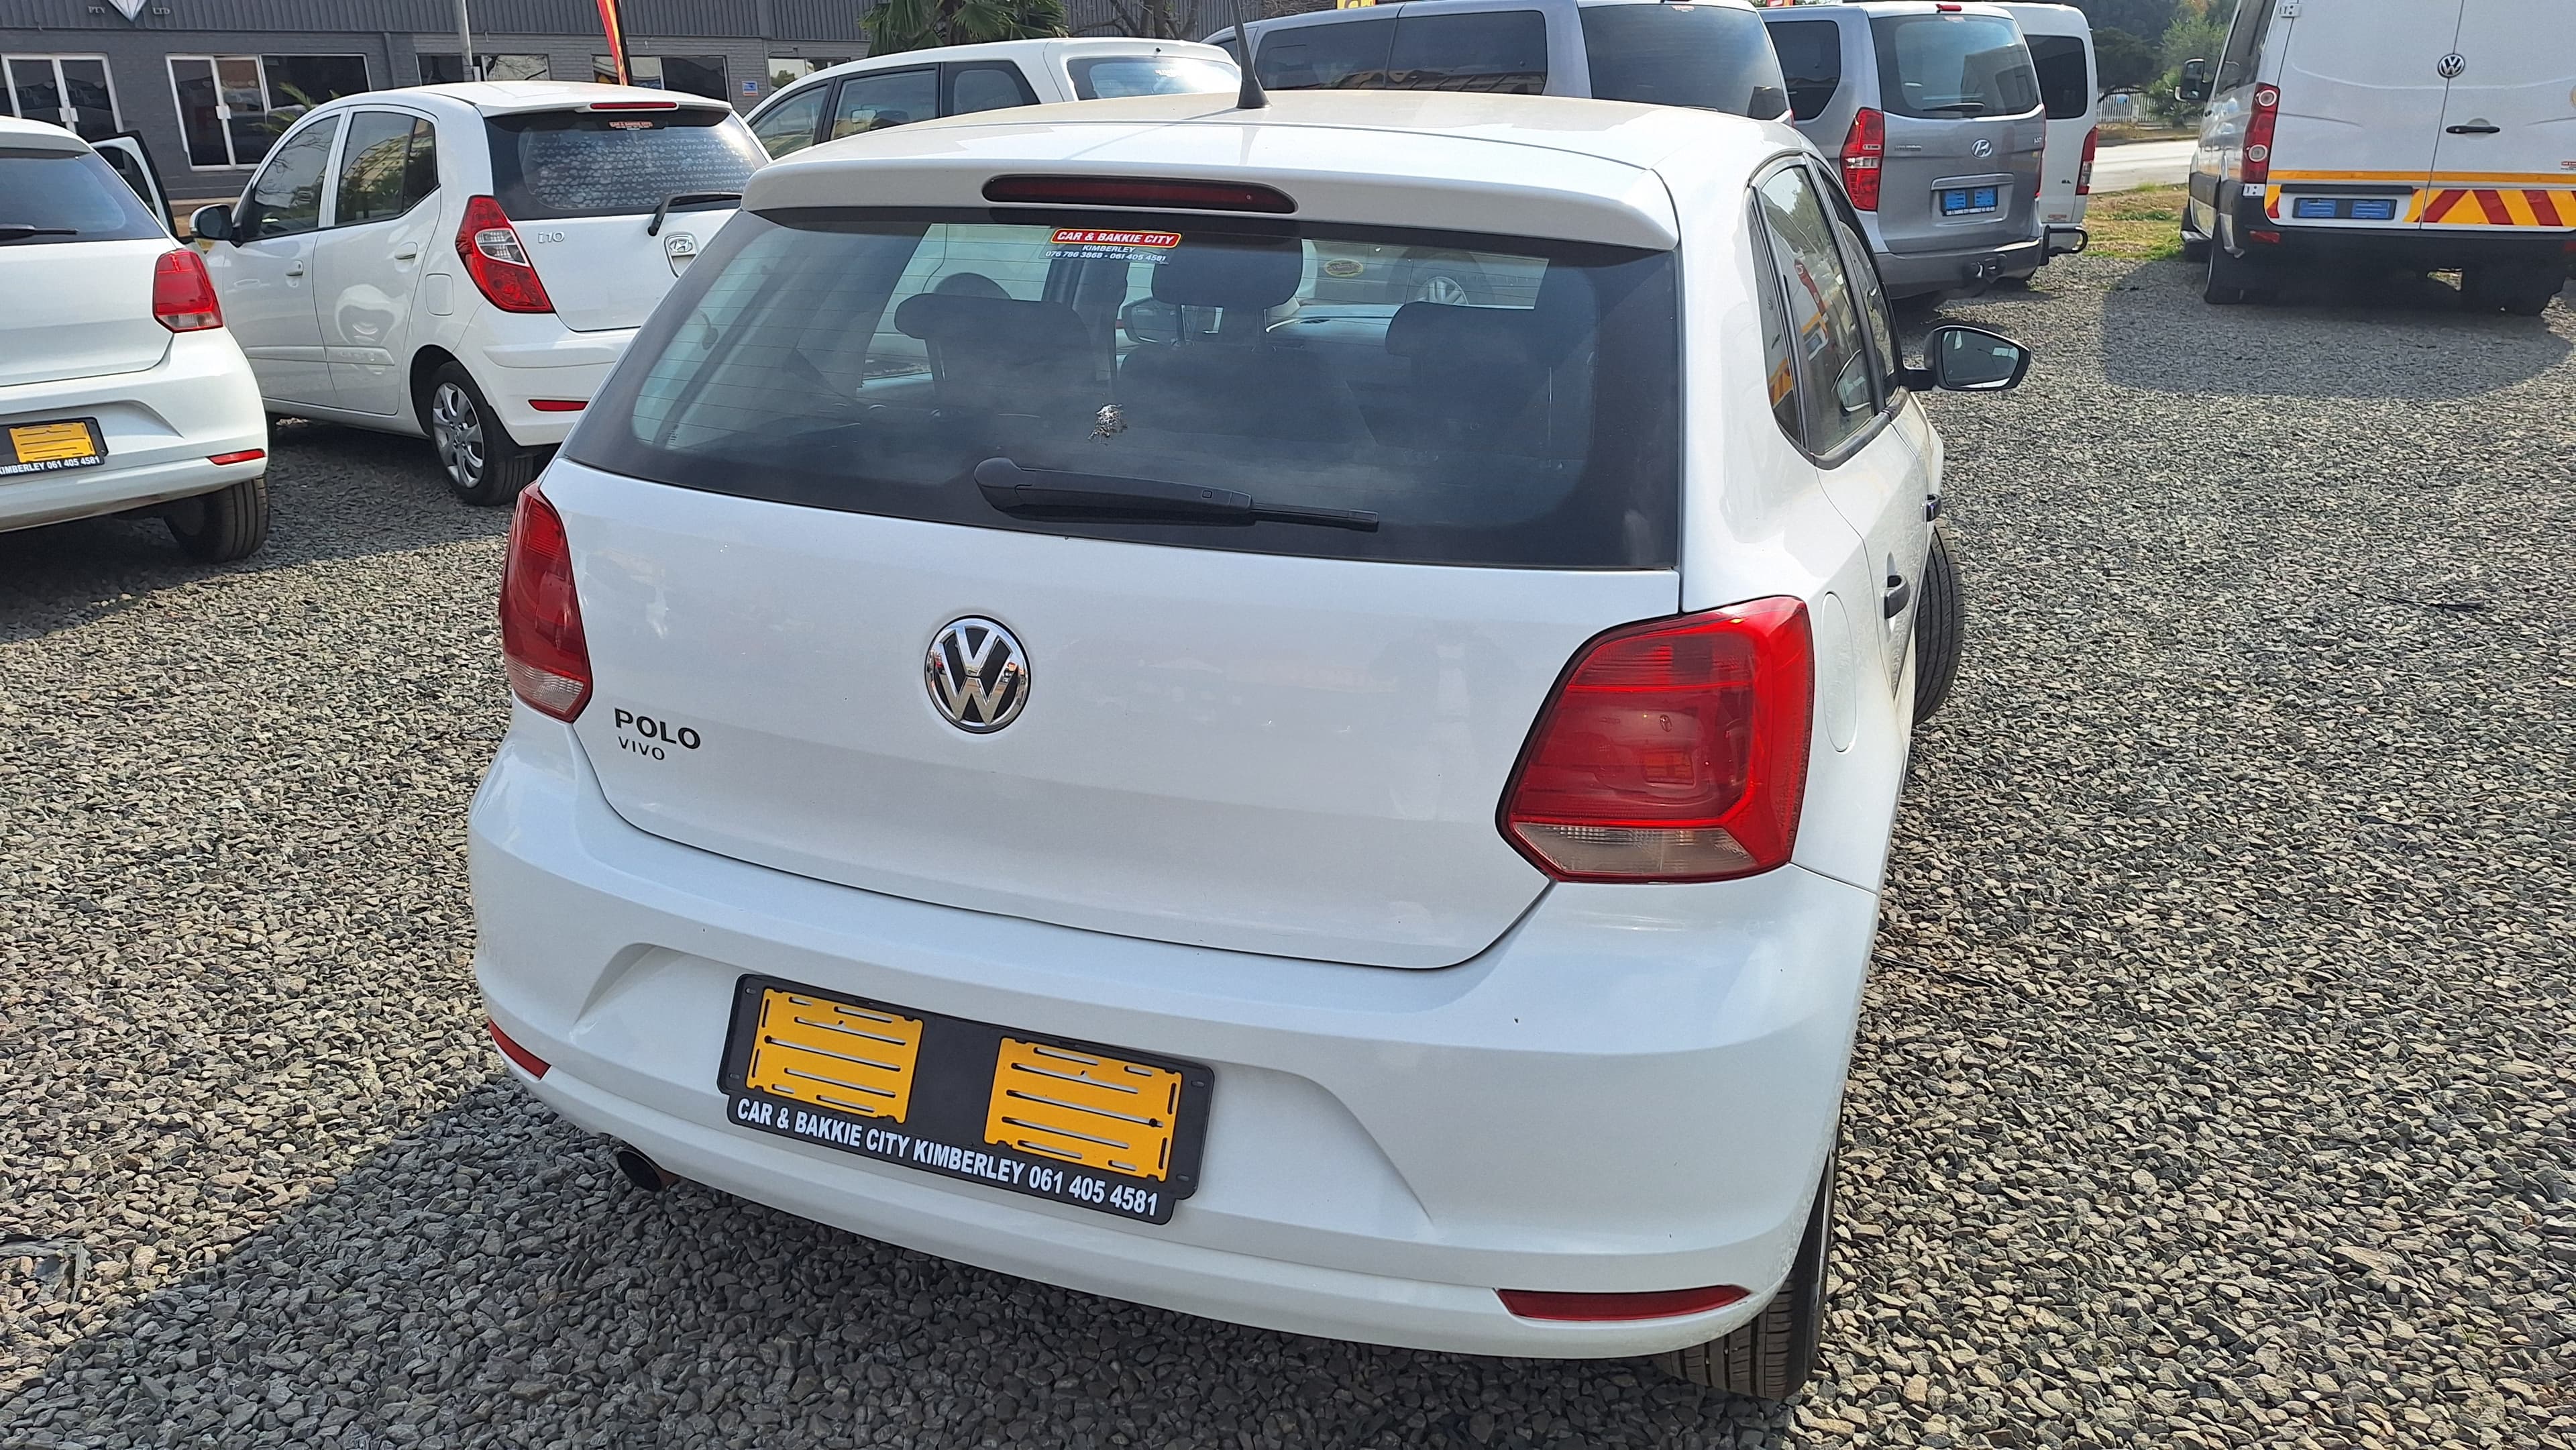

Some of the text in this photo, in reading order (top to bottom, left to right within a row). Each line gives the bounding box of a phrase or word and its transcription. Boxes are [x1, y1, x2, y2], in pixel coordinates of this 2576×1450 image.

[88, 6, 170, 15] PTY LTD
[1057, 231, 1175, 244] CAR & BAKKIE CITY
[1082, 244, 1136, 252] KIMBERLEY
[46, 460, 62, 469] 061
[64, 458, 79, 467] 405
[80, 456, 100, 466] 4581
[614, 708, 701, 749] POLO
[619, 736, 665, 760] VIVO
[738, 1098, 1159, 1216] CAR & BAKKIE CITY KIMBERLEY 061 405 4581
